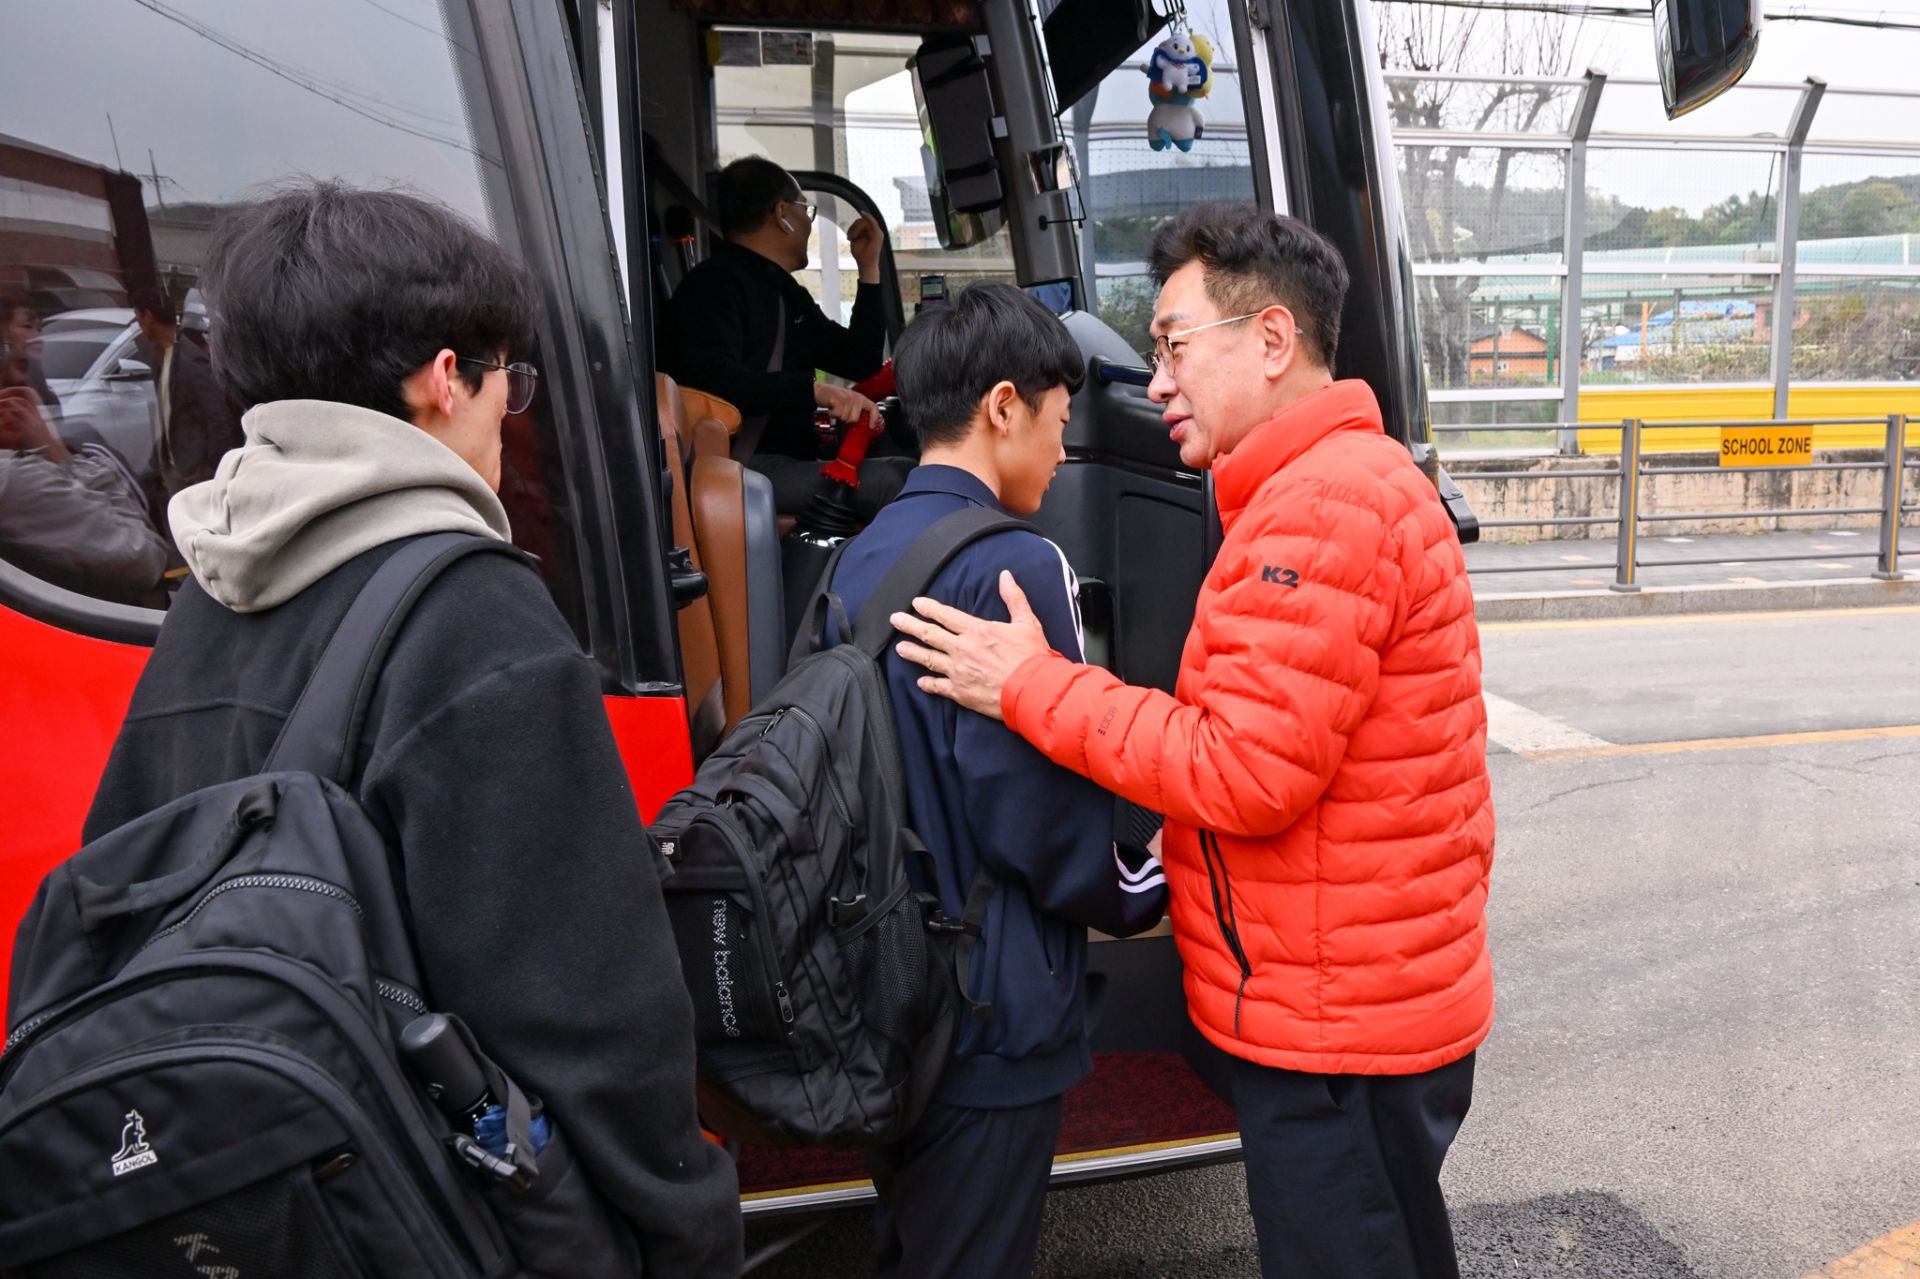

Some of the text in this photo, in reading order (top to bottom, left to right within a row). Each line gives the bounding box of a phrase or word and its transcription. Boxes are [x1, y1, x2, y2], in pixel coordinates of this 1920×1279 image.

[1722, 437, 1811, 455] SCHOOL ZONE
[1262, 565, 1299, 588] K2
[713, 900, 727, 945] new
[115, 1154, 155, 1174] KANGOL
